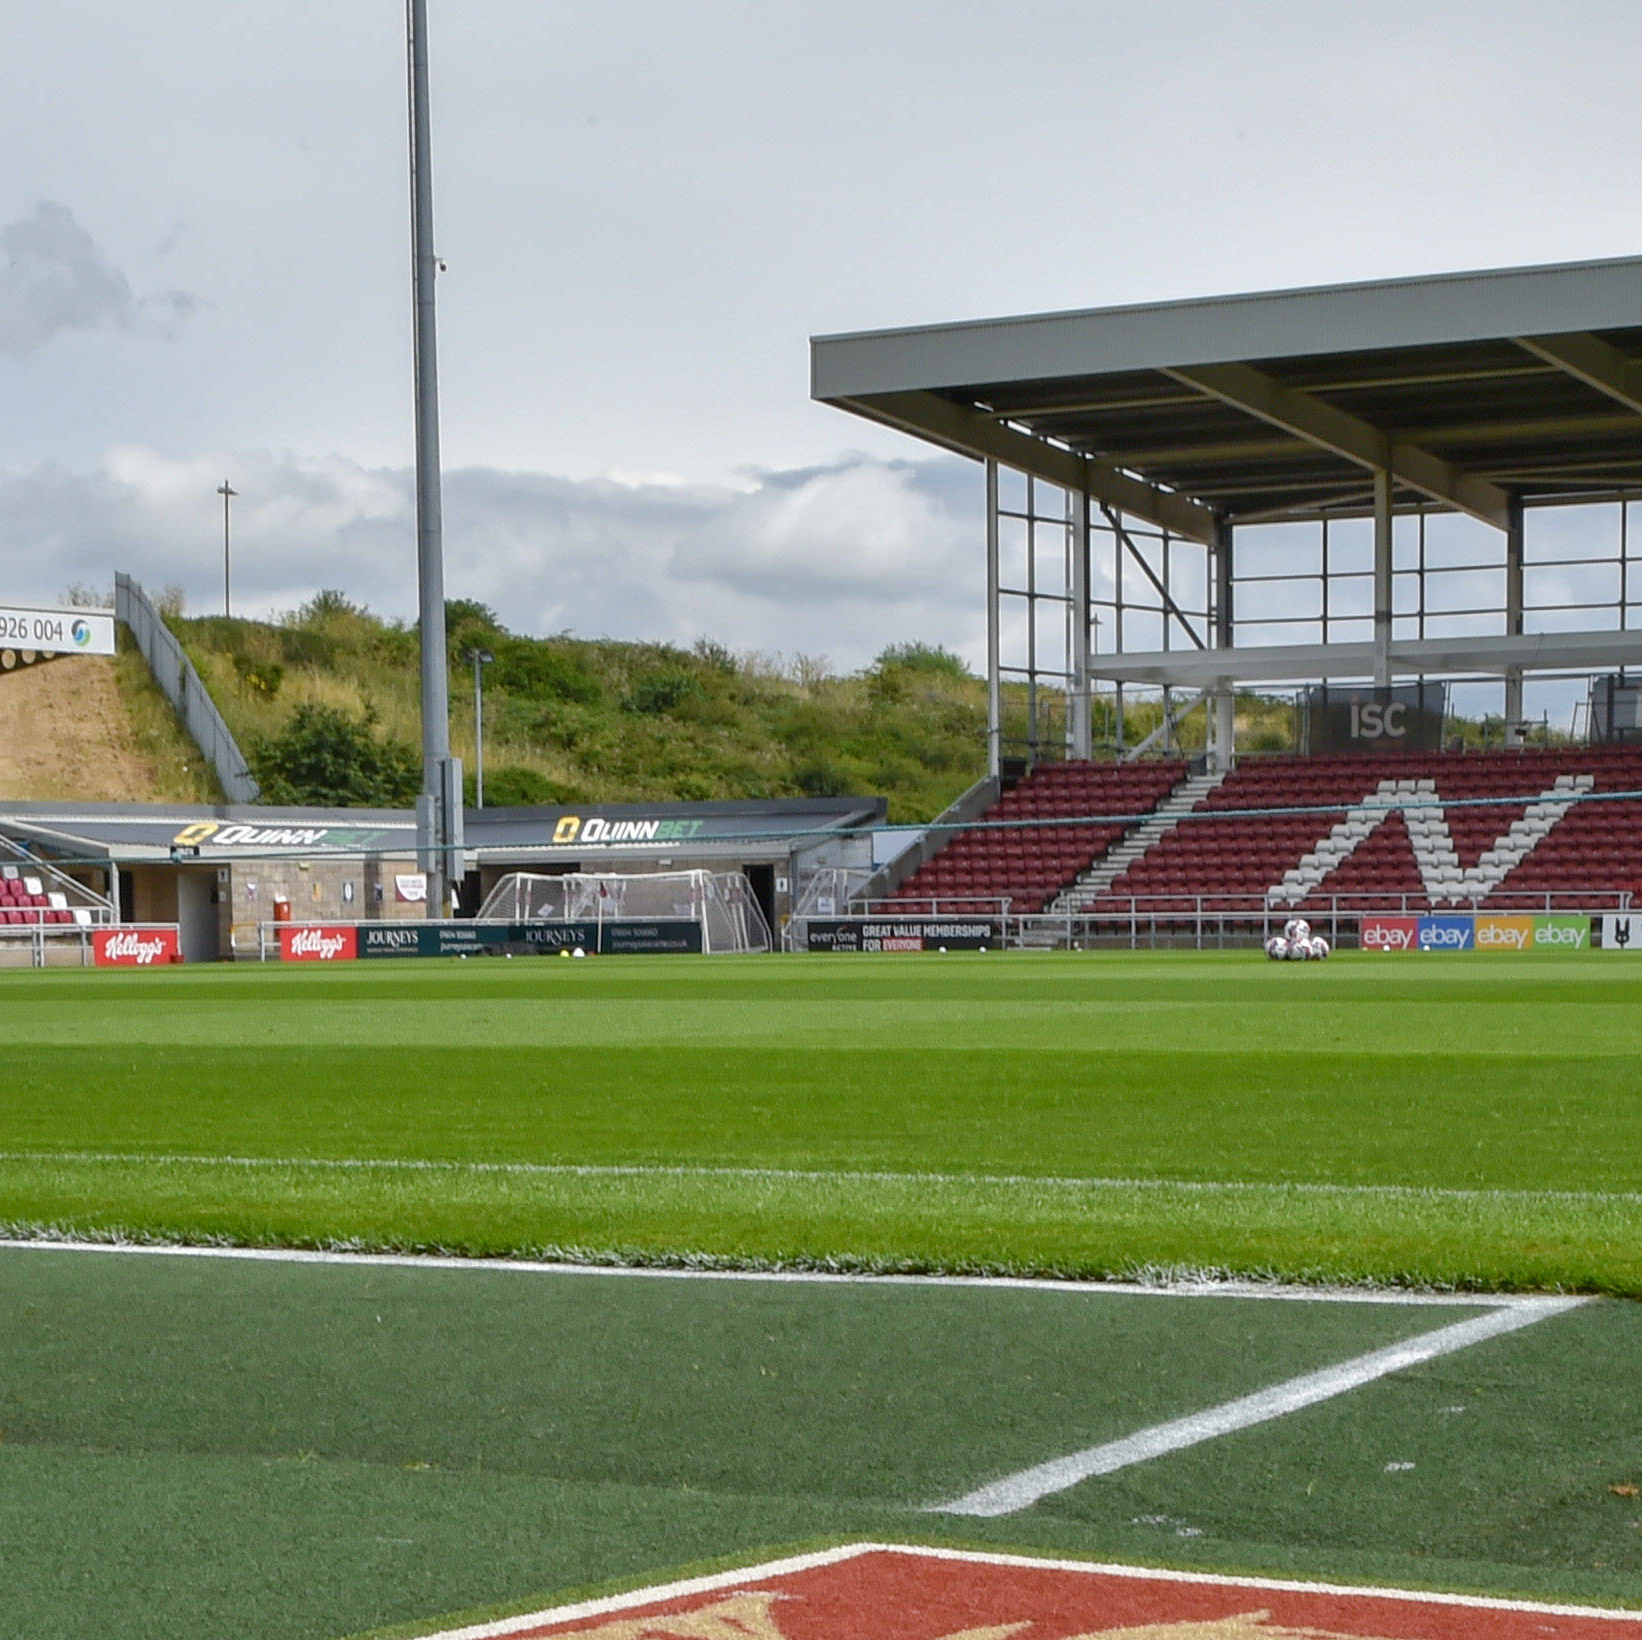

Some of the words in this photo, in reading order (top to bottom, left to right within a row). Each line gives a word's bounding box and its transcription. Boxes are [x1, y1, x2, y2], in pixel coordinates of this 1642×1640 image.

[33, 618, 64, 642] 004
[367, 930, 419, 948] JOURNEYS
[862, 924, 891, 938] GREAT
[893, 924, 922, 938] VALUE
[924, 924, 991, 938] MEMBERSHIPS
[1363, 923, 1413, 950] ebay
[1420, 923, 1470, 950] ebay
[1477, 923, 1528, 950] ebay
[1535, 923, 1586, 949] ebay
[862, 938, 881, 951] FOR
